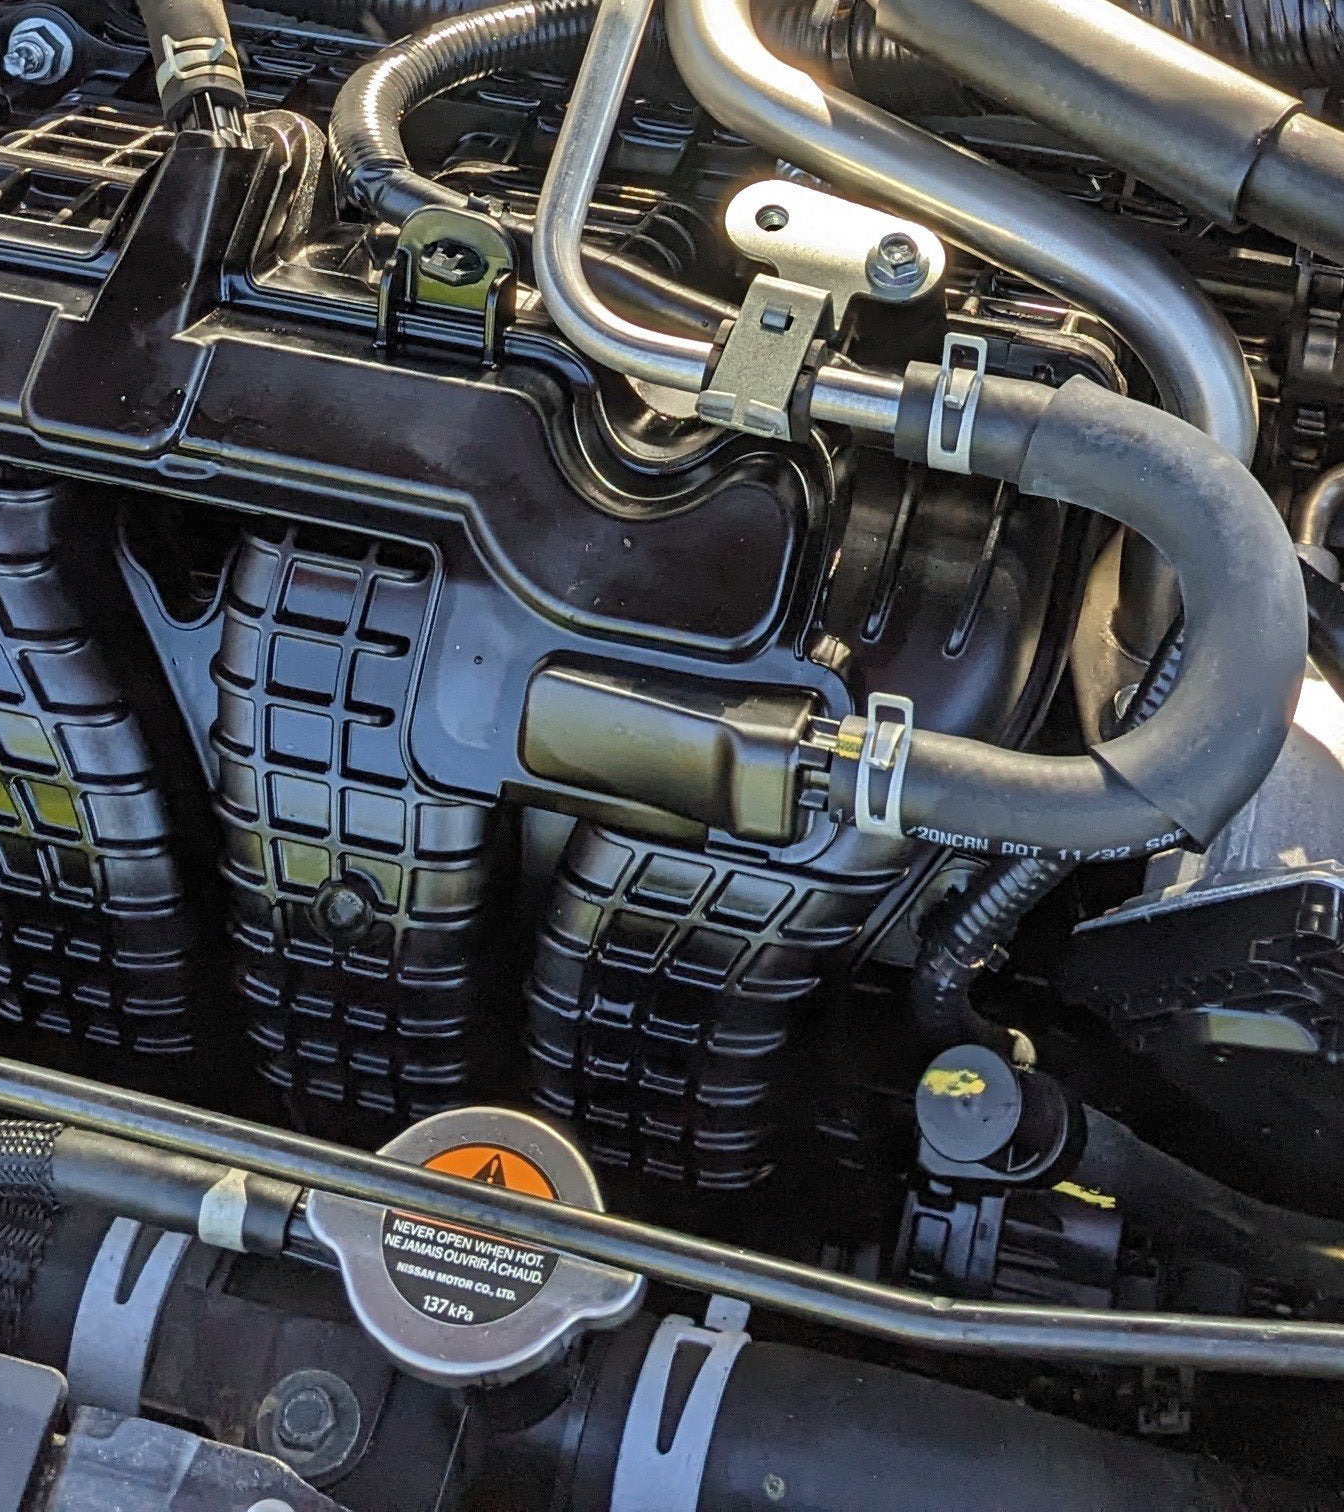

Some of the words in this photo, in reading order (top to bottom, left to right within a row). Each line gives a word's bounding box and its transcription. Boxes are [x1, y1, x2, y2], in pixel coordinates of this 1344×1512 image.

[1000, 841, 1042, 857] DOT
[384, 1232, 403, 1249] NE
[401, 1238, 445, 1259] JAMAIS
[443, 1249, 490, 1271] OUVRIR
[497, 1263, 543, 1285] CHAUD.
[393, 1219, 436, 1241] NEVER
[436, 1231, 473, 1250] OPEN
[475, 1240, 515, 1261] WHEN
[515, 1251, 544, 1268] HOT.
[396, 1261, 436, 1280] NISSAN
[436, 1272, 474, 1290] MOTOR
[495, 1287, 516, 1301] LTD.
[423, 1294, 449, 1314] 137
